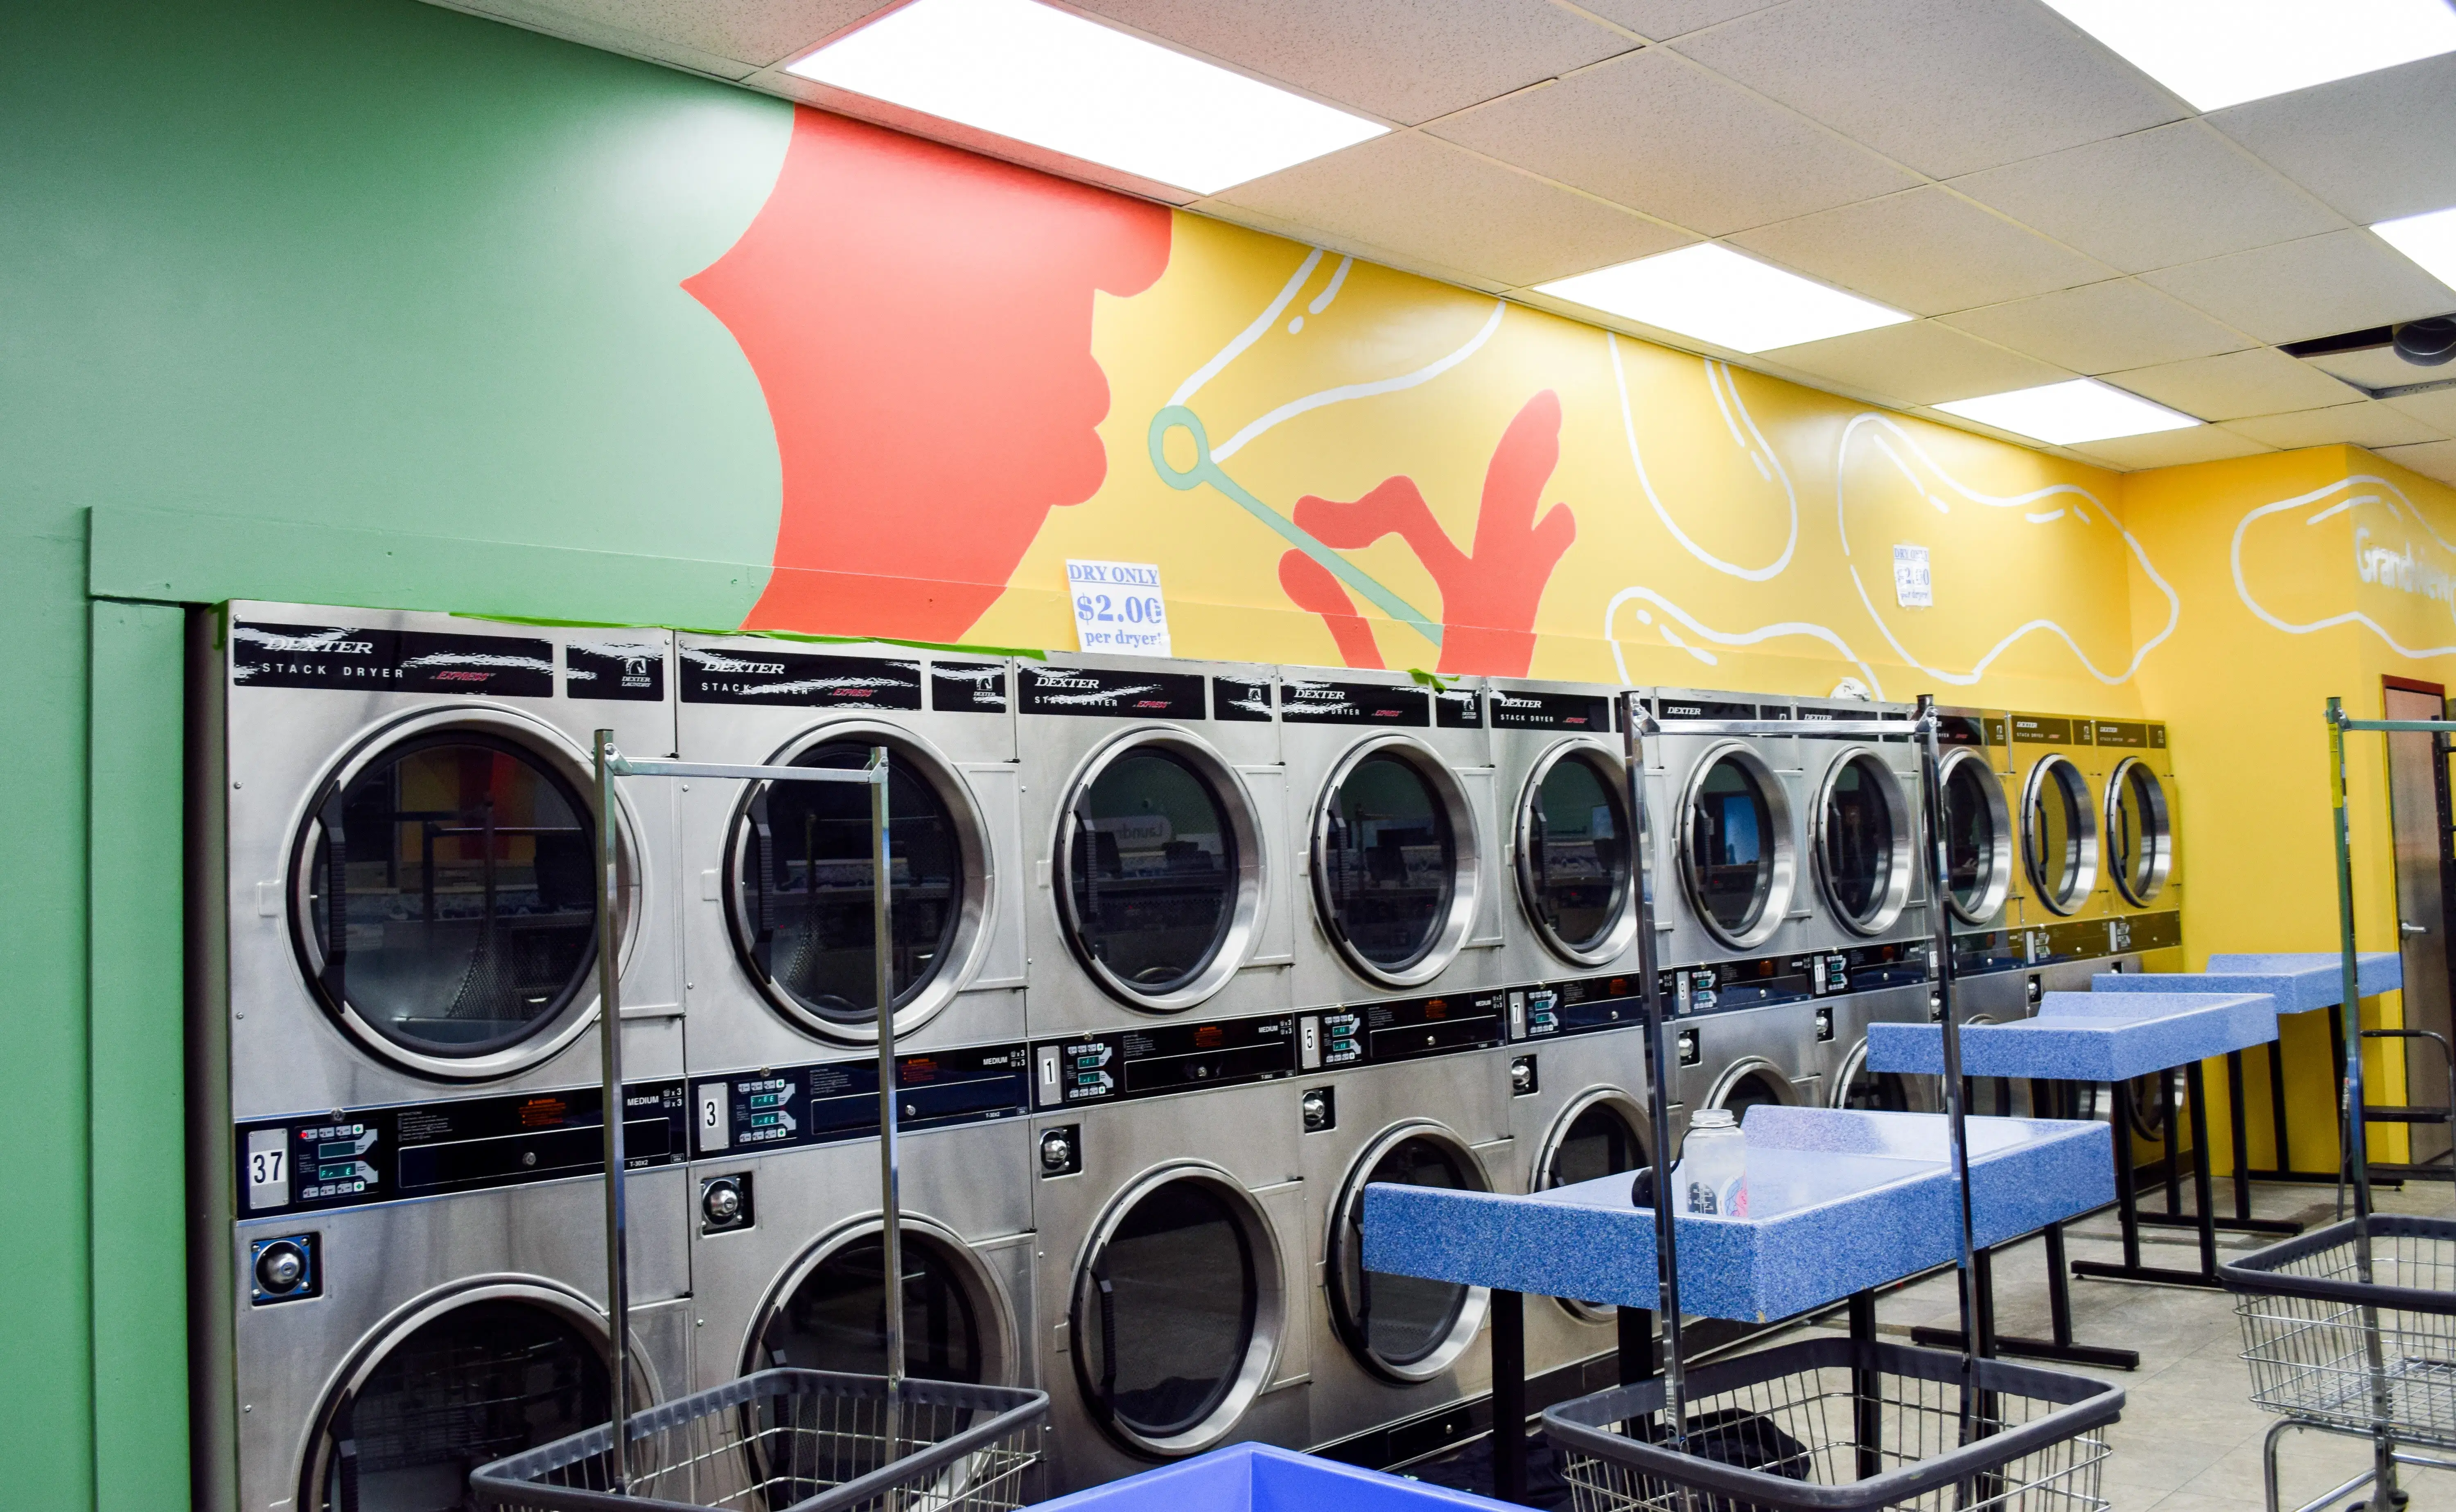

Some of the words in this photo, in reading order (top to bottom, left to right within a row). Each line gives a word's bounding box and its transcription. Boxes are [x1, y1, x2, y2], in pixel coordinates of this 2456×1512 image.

[1068, 564, 1107, 581] DRY
[1112, 567, 1158, 584] ONLY
[1077, 592, 1162, 625] $2.00
[263, 638, 373, 654] DEXTER
[1085, 632, 1111, 646] per
[262, 663, 327, 675] STACK
[343, 667, 403, 678] DRYER
[702, 661, 785, 674] DEXTER
[436, 671, 490, 681] EXPRESS
[1035, 677, 1099, 688] DEXTER
[702, 682, 752, 694] STACK
[1294, 690, 1345, 700] DEXTER
[1500, 699, 1542, 708] DEXTER
[1667, 707, 1701, 715] DEXTER
[1680, 983, 1685, 998] 9
[1514, 1005, 1518, 1022] 7
[1307, 1029, 1313, 1049] 5
[983, 1056, 1008, 1065] MEDIUM
[1047, 1061, 1052, 1082] 1
[677, 1088, 682, 1096] 3
[627, 1096, 659, 1106] MEDIUM
[707, 1101, 716, 1126] 3
[253, 1151, 283, 1183] 37
